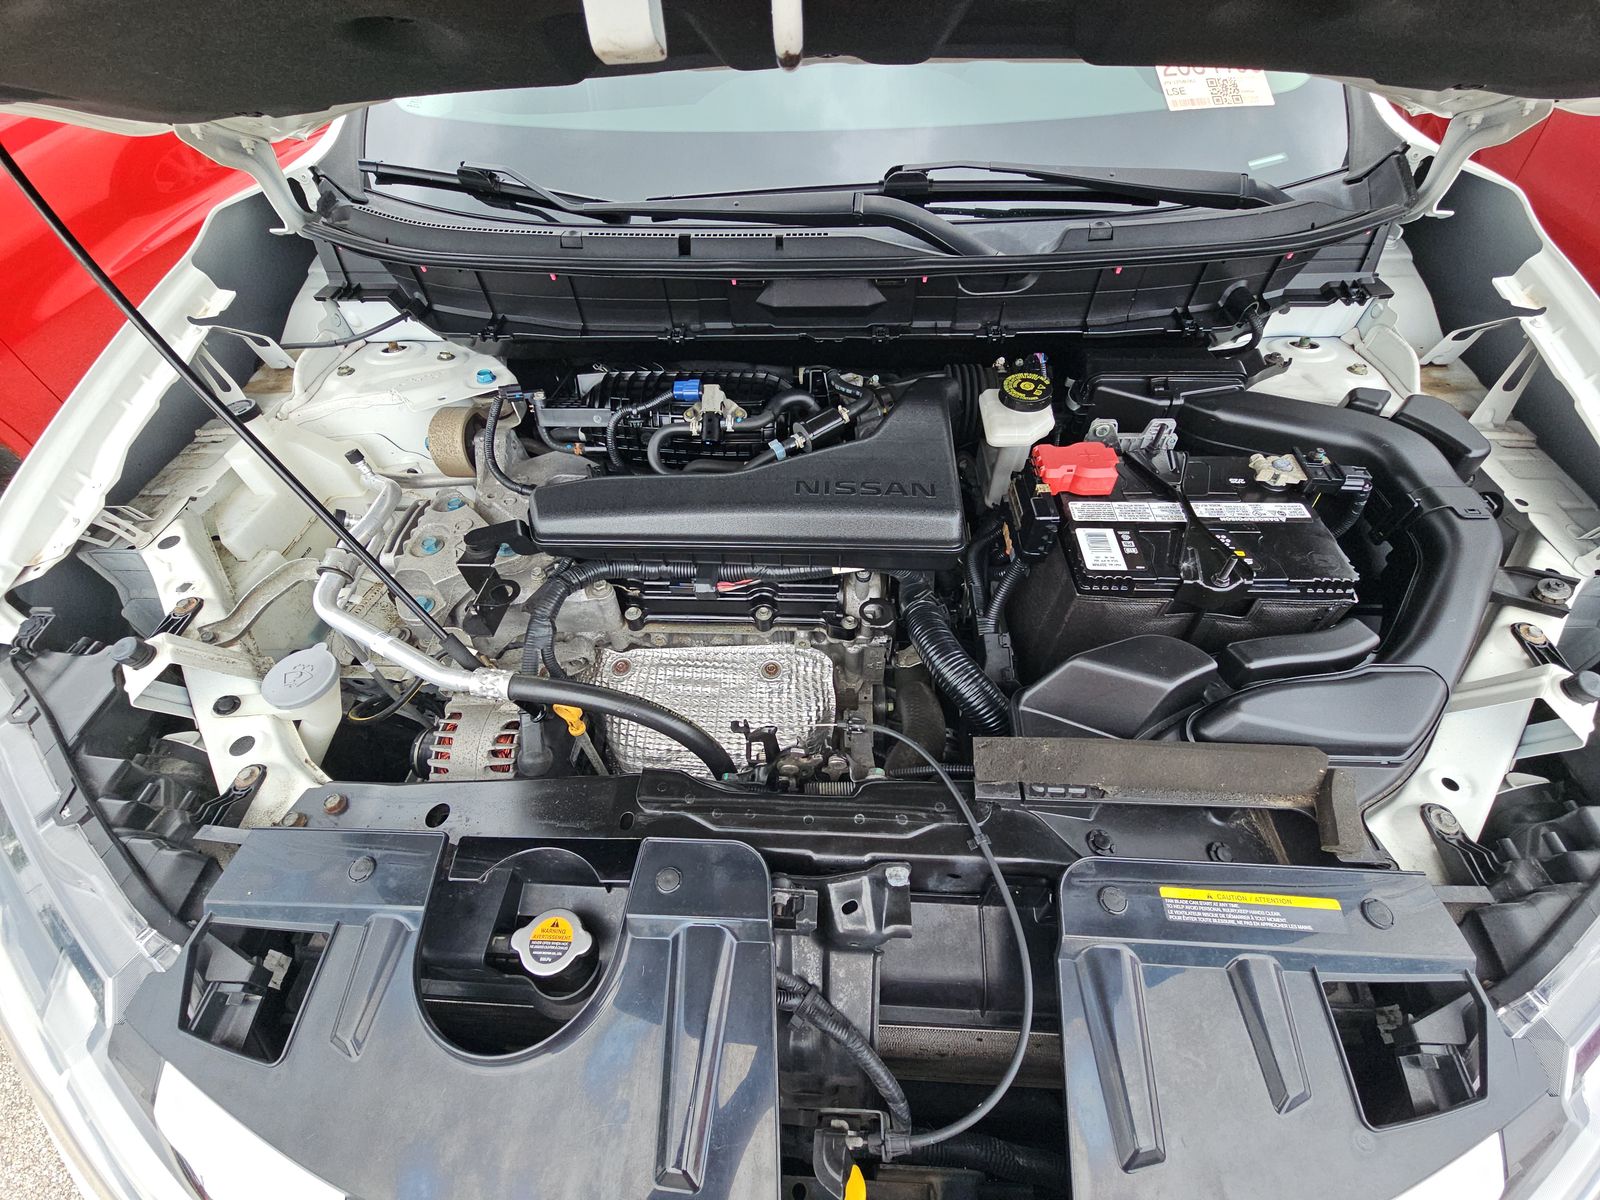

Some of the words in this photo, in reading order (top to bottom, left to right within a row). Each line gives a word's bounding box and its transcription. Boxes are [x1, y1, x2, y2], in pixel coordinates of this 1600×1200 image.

[1166, 86, 1187, 97] LSE
[795, 480, 937, 499] NISSAN
[1217, 893, 1247, 901] CAUTION
[1255, 896, 1293, 904] ATTENTION
